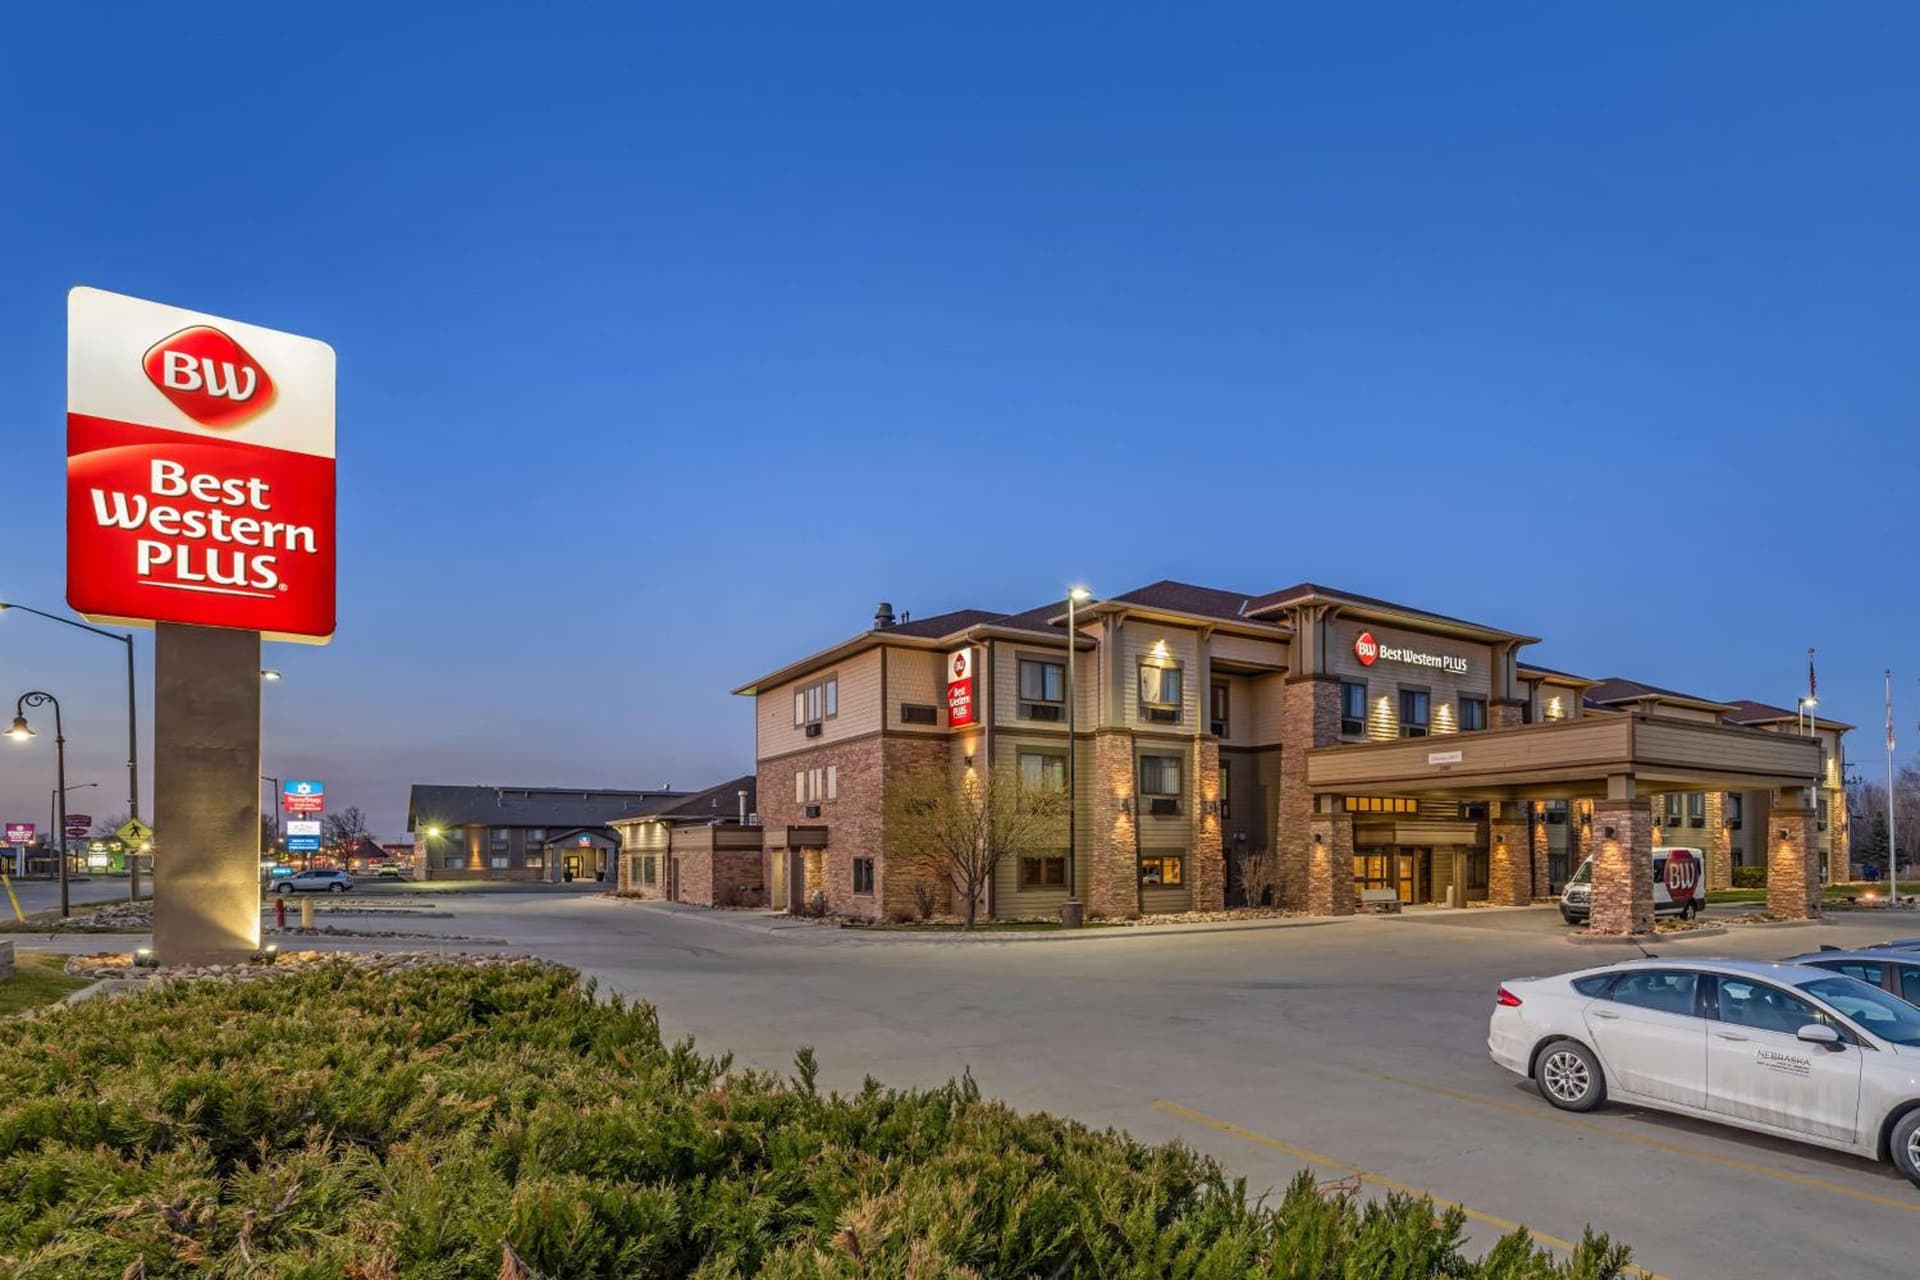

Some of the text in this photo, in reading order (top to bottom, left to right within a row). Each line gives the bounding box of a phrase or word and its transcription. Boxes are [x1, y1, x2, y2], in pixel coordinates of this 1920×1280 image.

[164, 350, 256, 401] BW
[151, 459, 271, 510] Best
[91, 488, 318, 553] Western
[1358, 642, 1468, 671] BW Best Western PLUS
[1670, 863, 1695, 889] BW
